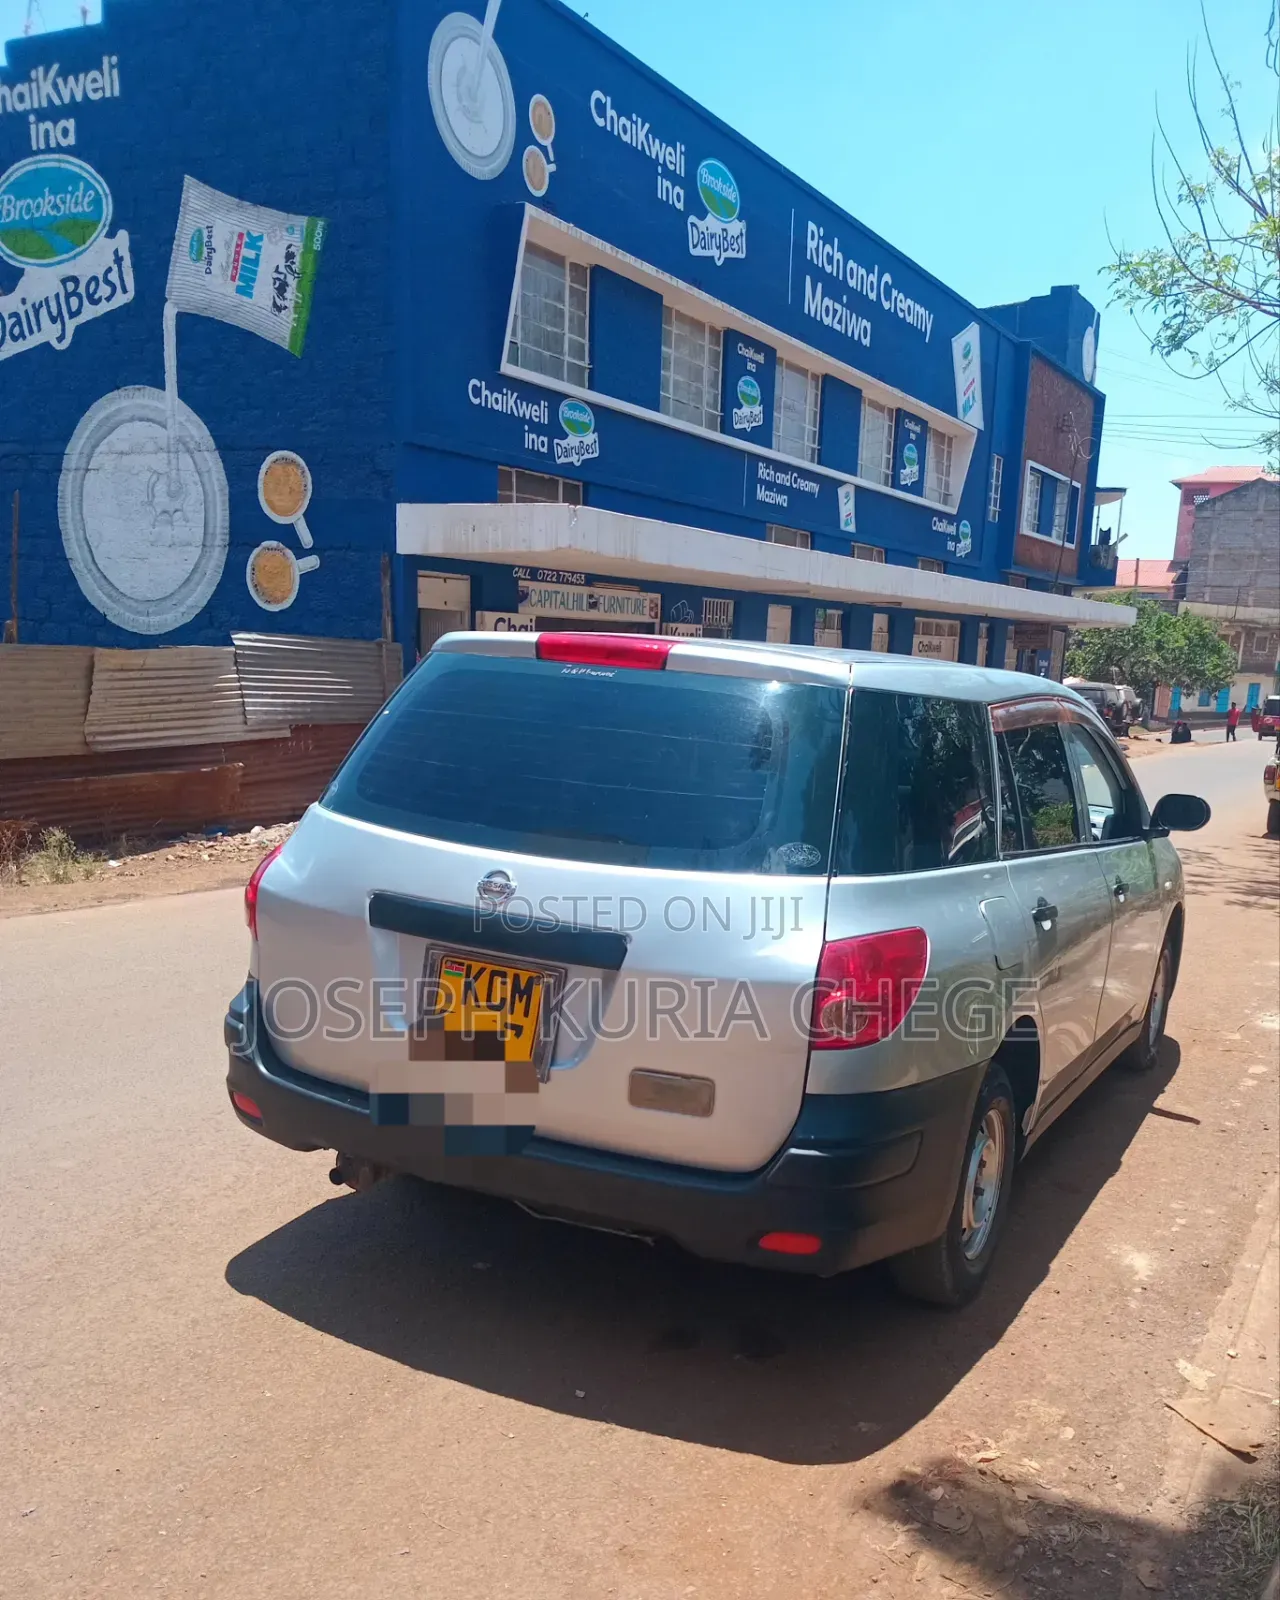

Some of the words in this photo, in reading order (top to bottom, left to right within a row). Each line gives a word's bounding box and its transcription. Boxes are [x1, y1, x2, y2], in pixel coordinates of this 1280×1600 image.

[28, 113, 76, 151] ina
[590, 90, 686, 177] ChaiKweli
[0, 181, 96, 223] Brookside
[657, 166, 685, 212] ina
[700, 167, 738, 203] Brookside
[204, 224, 216, 275] DairyBest
[689, 222, 745, 262] DairyBest
[235, 229, 265, 300] MILK
[806, 220, 844, 281] Rich
[846, 258, 879, 303] and
[880, 272, 934, 343] Creamy
[803, 275, 872, 348] Maziwa
[467, 378, 549, 425] ChaiKweli
[524, 429, 548, 454] ina
[555, 438, 598, 463] DairyBest
[756, 483, 789, 508] Maziwa
[757, 461, 775, 482] Rich
[775, 469, 792, 487] and
[791, 472, 820, 499] Creamy
[512, 567, 531, 580] CALL
[537, 569, 558, 582] 0722
[597, 593, 648, 616] FURNITURE
[462, 964, 535, 1019] KCM
